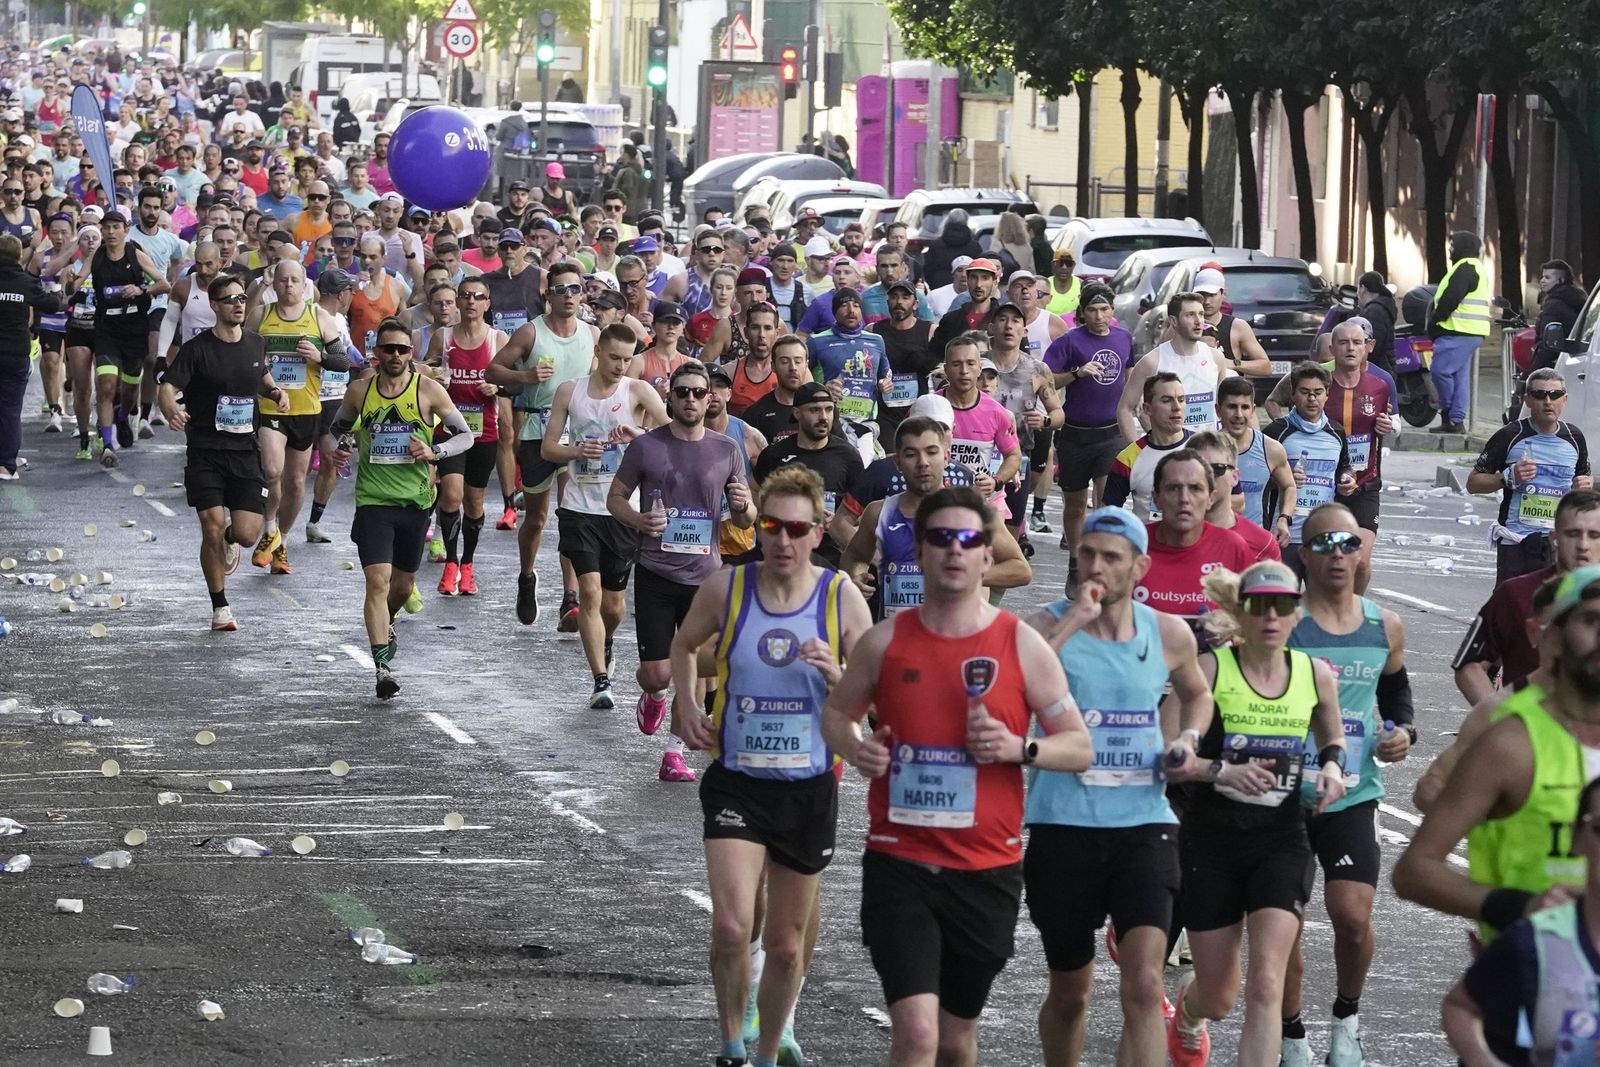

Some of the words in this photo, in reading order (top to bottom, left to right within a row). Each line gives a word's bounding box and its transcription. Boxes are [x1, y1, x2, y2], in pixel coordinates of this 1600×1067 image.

[451, 34, 471, 45] 30
[277, 373, 297, 381] JOHN
[890, 391, 909, 400] JULIO
[216, 417, 235, 425] MARC
[1184, 414, 1208, 423] HENRY
[1307, 477, 1330, 486] ZURICH
[1537, 487, 1563, 496] ZURICH
[681, 510, 708, 518] ZURICH
[680, 523, 696, 531] 6440
[673, 533, 701, 543] MARK
[901, 582, 919, 590] 6835
[760, 701, 804, 712] ZURICH
[1248, 703, 1289, 714] MORAY
[1106, 713, 1150, 725] ZURICH
[1223, 712, 1257, 725] ROAD
[1260, 716, 1311, 729] RUNNERS
[761, 722, 784, 732] 5637
[745, 736, 800, 751] RAZZYB
[1251, 736, 1296, 749] ZURICH
[916, 750, 967, 764] ZURICH
[1091, 752, 1143, 767] JULIEN
[903, 789, 957, 808] HARRY
